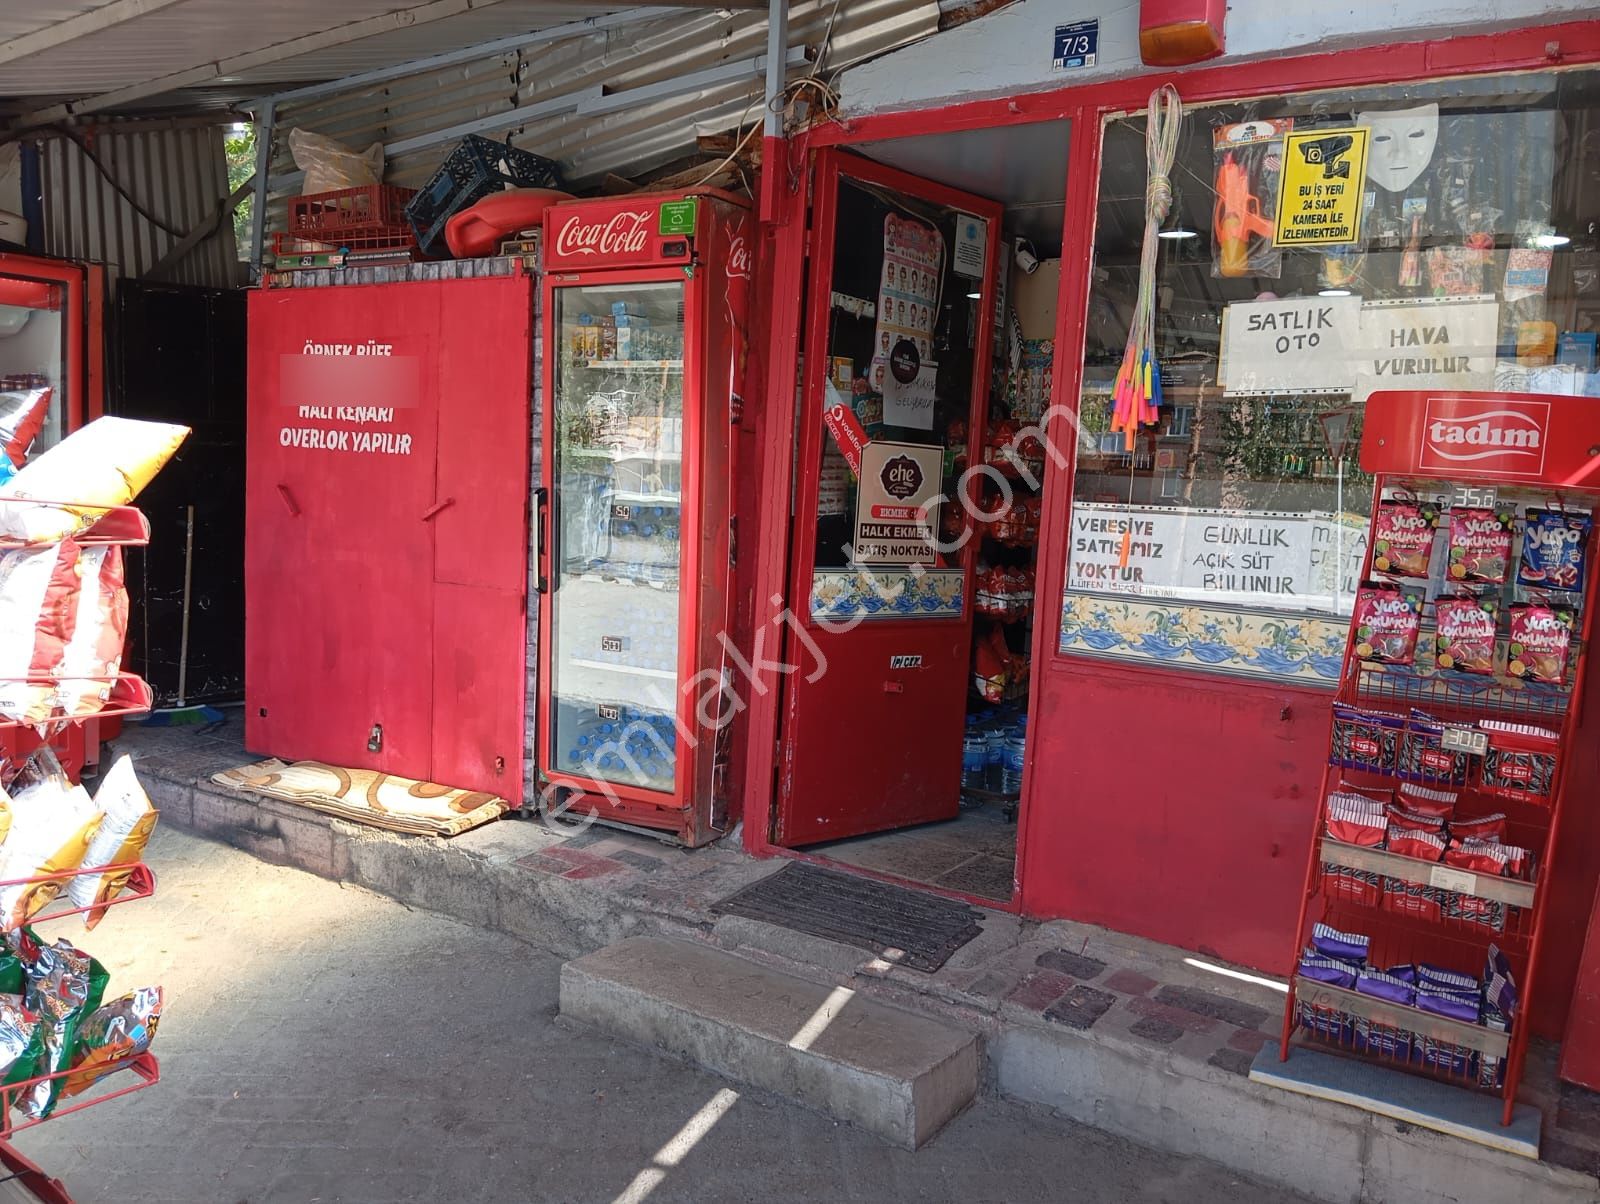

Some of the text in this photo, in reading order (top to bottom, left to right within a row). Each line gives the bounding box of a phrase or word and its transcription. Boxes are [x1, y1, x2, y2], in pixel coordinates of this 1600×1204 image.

[1062, 35, 1089, 56] 7/3
[1299, 182, 1345, 198] BU İŞ YERİ
[1302, 198, 1337, 210] 24 SAAT
[1292, 212, 1344, 226] KAMERA İLE
[556, 210, 655, 257] Coca-Cola
[1282, 225, 1349, 240] İZLENMEKTEDİR
[1247, 307, 1334, 332] SATLIK
[1275, 332, 1321, 354] OTO
[1389, 325, 1450, 348] HAVA
[1373, 355, 1472, 376] VURULUR
[279, 427, 412, 455] OVERLOK YAPILIR
[841, 419, 862, 453] vodafon
[1429, 421, 1540, 448] tadım
[889, 463, 915, 482] ehe
[861, 525, 932, 539] HALK EKMEK
[1077, 515, 1154, 536] VERESİYE
[1203, 523, 1290, 548] GÜNLÜK
[857, 544, 934, 558] SATIŞ NOKTASI
[1076, 537, 1164, 559] SATIŞMIZ
[1192, 551, 1274, 571] AÇIK SÜT
[1074, 561, 1144, 584] YOKTUR
